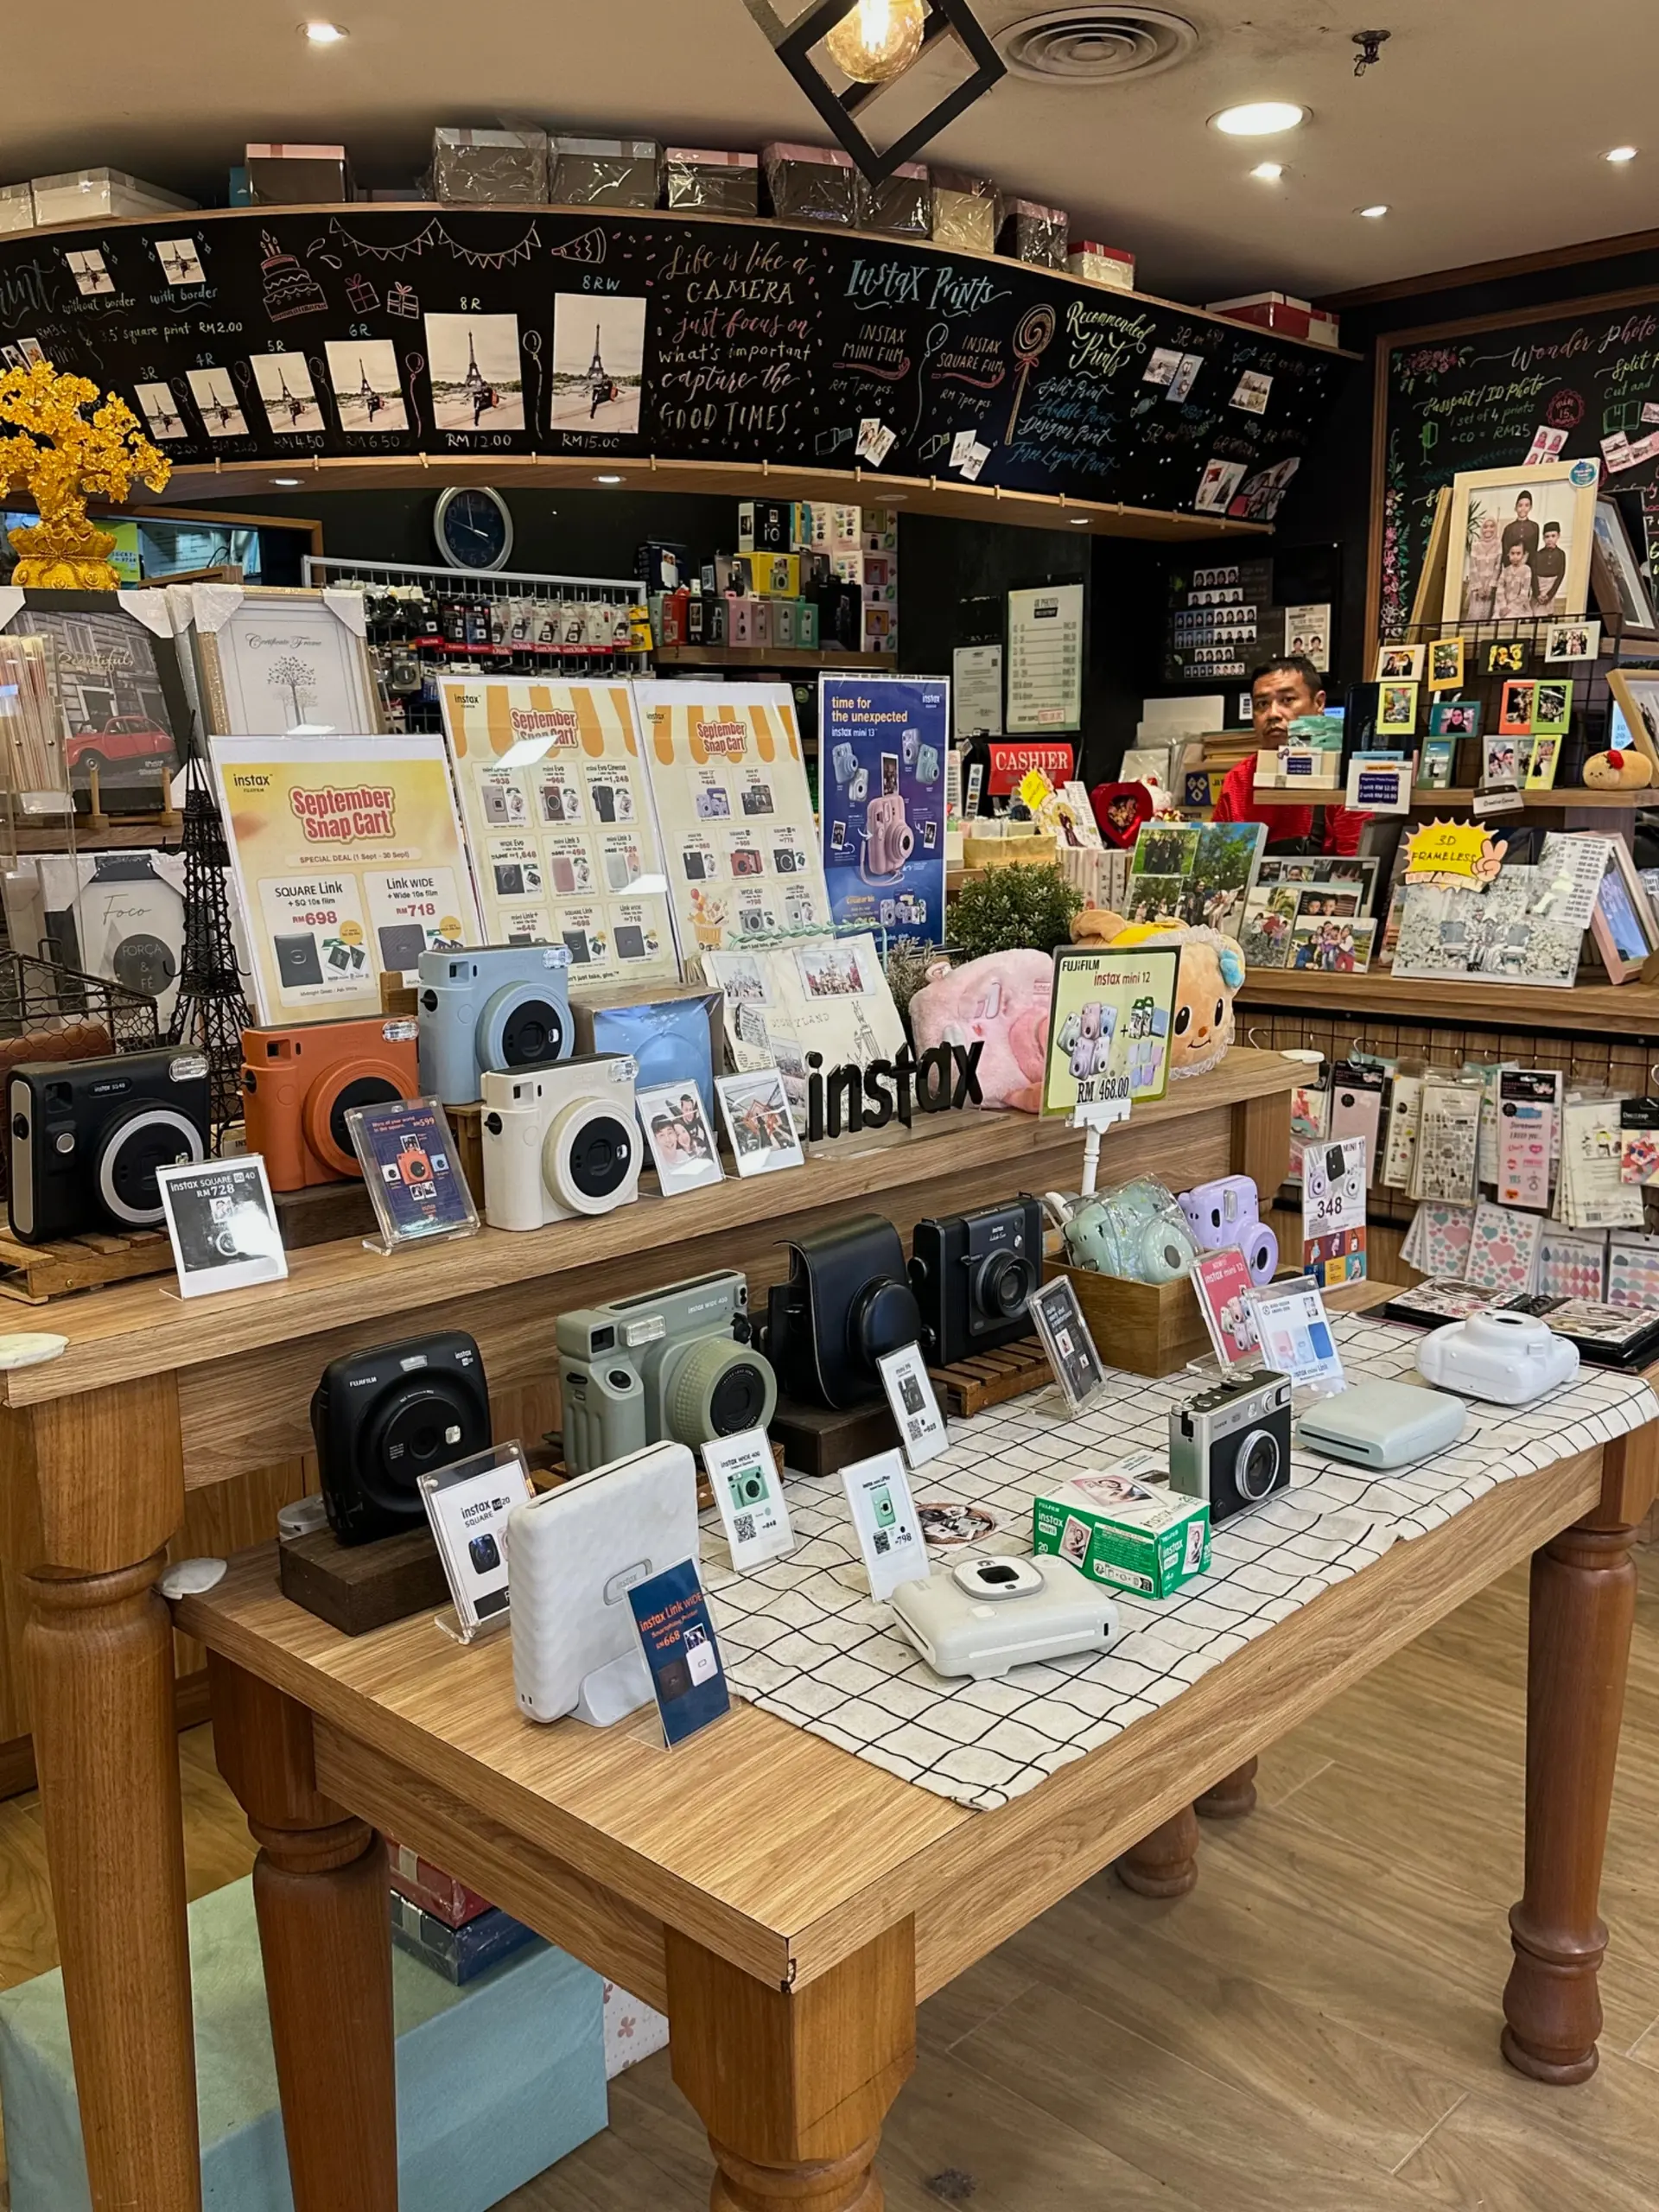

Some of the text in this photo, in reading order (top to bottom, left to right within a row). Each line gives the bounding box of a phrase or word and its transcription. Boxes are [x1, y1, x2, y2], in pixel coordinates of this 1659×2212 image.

[658, 241, 816, 279] Life is like a
[582, 275, 620, 289] 8RW
[149, 286, 218, 304] with border
[687, 280, 795, 305] CAMERA
[62, 293, 137, 314] without border
[460, 296, 481, 310] 8R
[672, 307, 813, 344] just focus on
[1066, 301, 1156, 342] Recommended
[123, 327, 158, 345] square
[163, 323, 191, 343] print
[199, 321, 243, 334] RM2.00
[348, 323, 372, 337] 6R
[859, 324, 907, 344] INSTAX
[267, 340, 286, 353] 5R
[962, 334, 1002, 353] INSTAX
[1499, 327, 1595, 372] Wonder
[195, 353, 215, 367] 4R
[658, 344, 810, 363] what's important
[842, 342, 904, 363] MINI FILM
[1069, 333, 1130, 377] Prints
[937, 352, 1005, 373] SQUARE FILM
[140, 366, 158, 380] 3R
[662, 362, 801, 402] capture the
[830, 379, 848, 391] RM
[1631, 374, 1654, 391] and
[940, 389, 954, 400] RM
[1071, 380, 1115, 403] Print
[659, 402, 791, 434] GOOD TIMES
[1018, 416, 1116, 447] Designer Print
[448, 433, 512, 448] RM12.00
[245, 632, 323, 650] Certificate Frame
[454, 694, 478, 704] instax
[831, 693, 940, 709] time for instax
[512, 710, 575, 730] September
[831, 710, 907, 725] the unexpected
[697, 722, 745, 740] September
[831, 726, 852, 737] instax
[853, 727, 868, 737] mini
[704, 736, 744, 753] Snap Cart
[995, 750, 1068, 771] CASHIER
[232, 772, 270, 787] instax
[292, 788, 392, 818] September
[305, 810, 391, 841] Snap Cart
[1439, 835, 1457, 846] 3D
[299, 854, 331, 863] SPECIAL
[333, 854, 351, 862] DEAL
[360, 853, 377, 862] Sept
[1411, 851, 1477, 863] FRAMELESS
[275, 880, 343, 897] SQUARE Link
[386, 876, 435, 890] Link WIDE
[394, 890, 410, 899] Wide
[103, 893, 152, 925] Foco
[295, 899, 306, 907] SQ
[396, 903, 435, 918] RM718
[292, 911, 338, 925] RM698
[122, 944, 162, 958] FORÇA
[140, 962, 149, 973] &
[1062, 959, 1100, 972] FUJIFILM
[141, 976, 154, 990] FÉ
[1094, 971, 1151, 987] instax mini 12
[805, 1039, 985, 1142] instax
[1077, 1077, 1130, 1103] RM 468.00
[1343, 1141, 1357, 1152] MINI
[171, 1179, 198, 1192] instax
[200, 1175, 232, 1187] SQUARE
[245, 1172, 256, 1180] 40
[196, 1184, 235, 1198] RM728
[1317, 1197, 1343, 1218] 348
[1205, 1271, 1224, 1284] instax
[1224, 1268, 1236, 1277] mini
[688, 1303, 704, 1314] instax
[349, 1376, 377, 1387] FUJIFILM
[720, 1457, 737, 1469] instax
[738, 1453, 751, 1463] WIDE
[461, 1499, 491, 1520] instax
[465, 1511, 493, 1529] SQUARE
[1039, 1510, 1063, 1528] instax
[1040, 1524, 1057, 1535] mini
[1038, 1541, 1049, 1553] 20
[1163, 1538, 1184, 1554] instax
[616, 1573, 638, 1588] instax
[639, 1592, 702, 1632] instax Link WIDE
[656, 1630, 681, 1649] RM668
